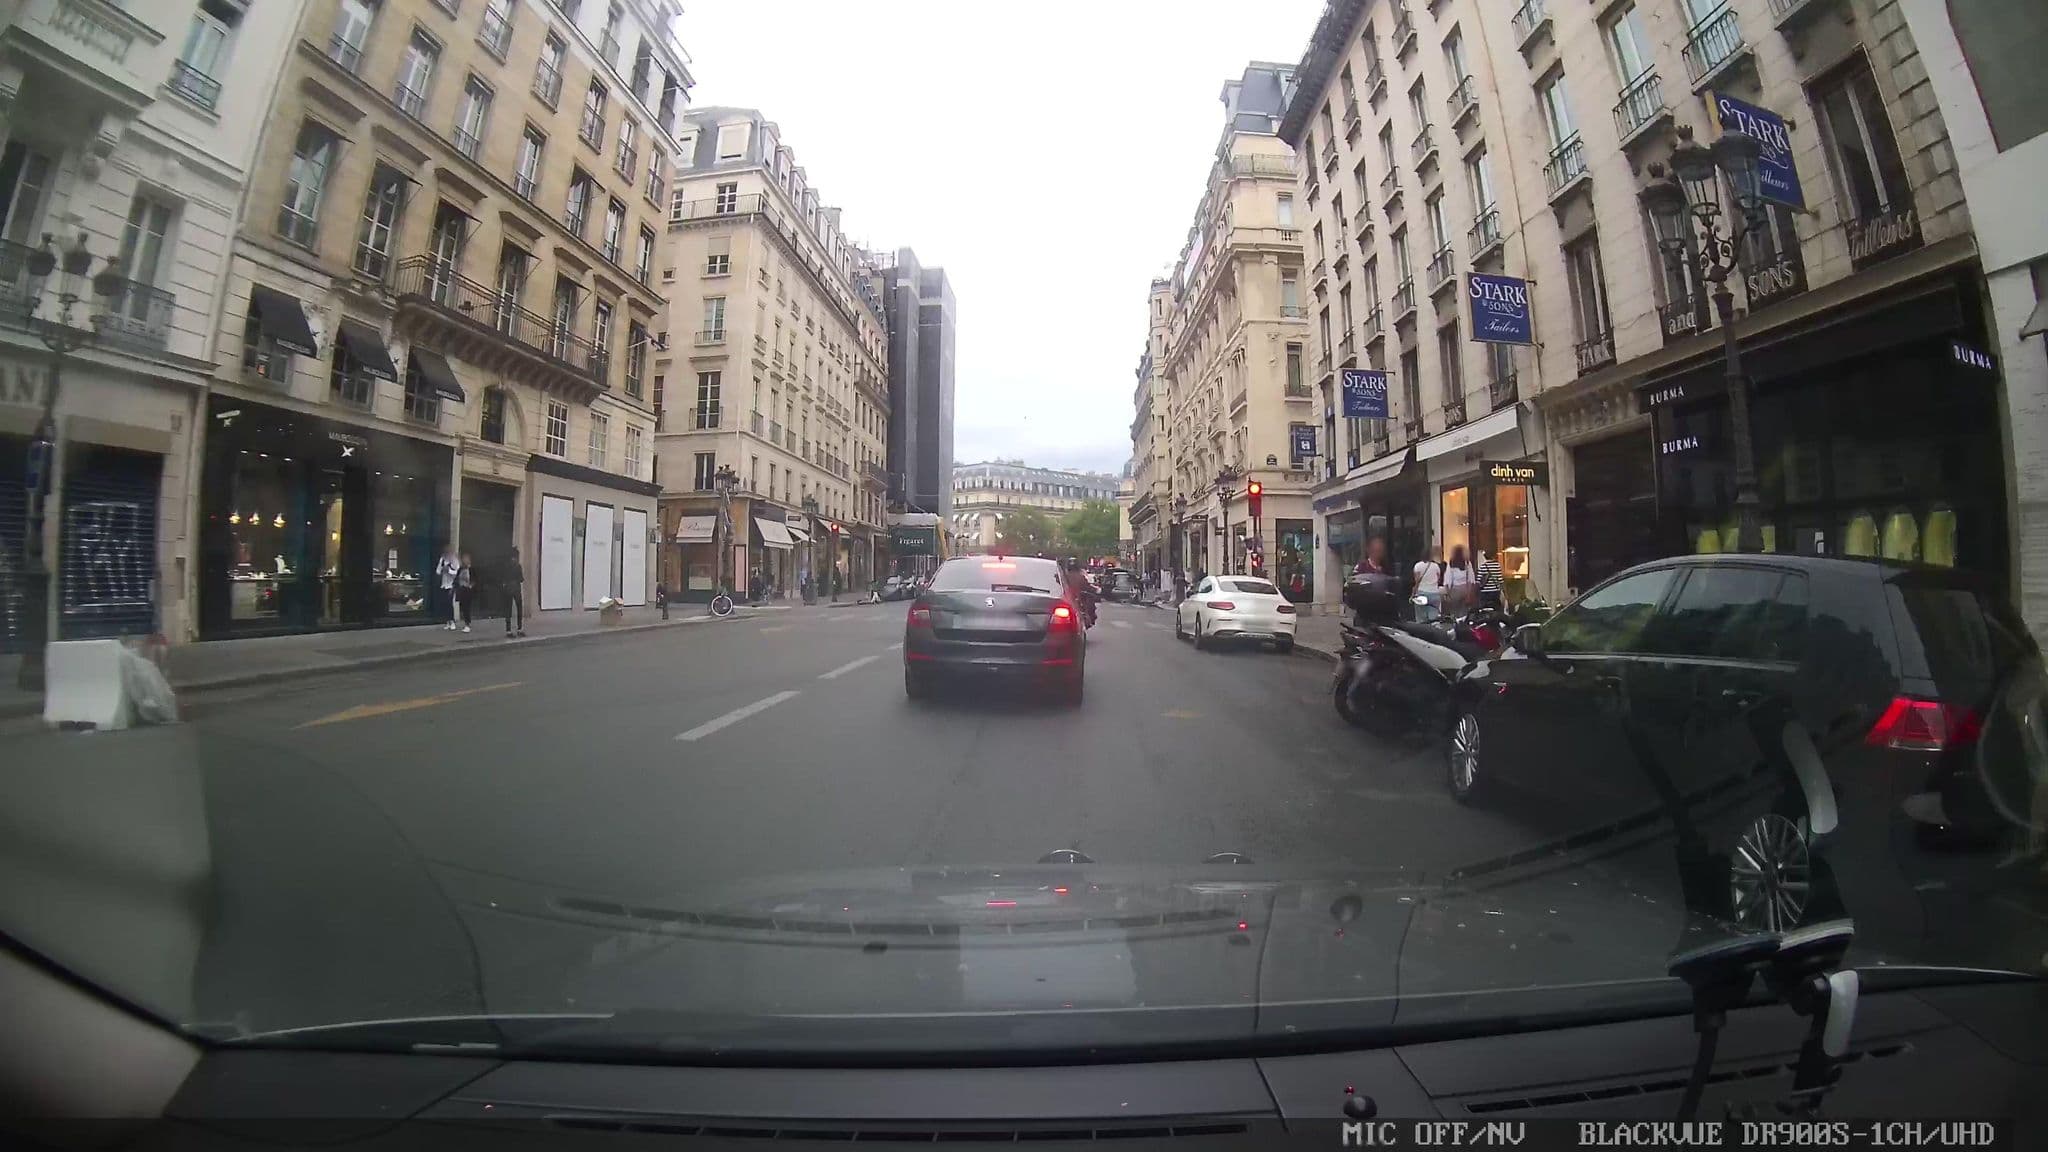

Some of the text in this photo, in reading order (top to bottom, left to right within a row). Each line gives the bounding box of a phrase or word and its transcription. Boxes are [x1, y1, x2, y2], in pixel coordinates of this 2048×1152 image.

[1720, 99, 1790, 154] STARK
[1748, 261, 1793, 301] SONS
[1469, 276, 1527, 308] STARK
[1488, 301, 1514, 313] SONS
[1953, 344, 1992, 370] BURMA
[1343, 371, 1387, 393] STARK
[1356, 388, 1376, 397] SONS
[1650, 386, 1685, 406] BURMA
[1662, 436, 1699, 454] BURMA
[1490, 463, 1535, 478] dinh van
